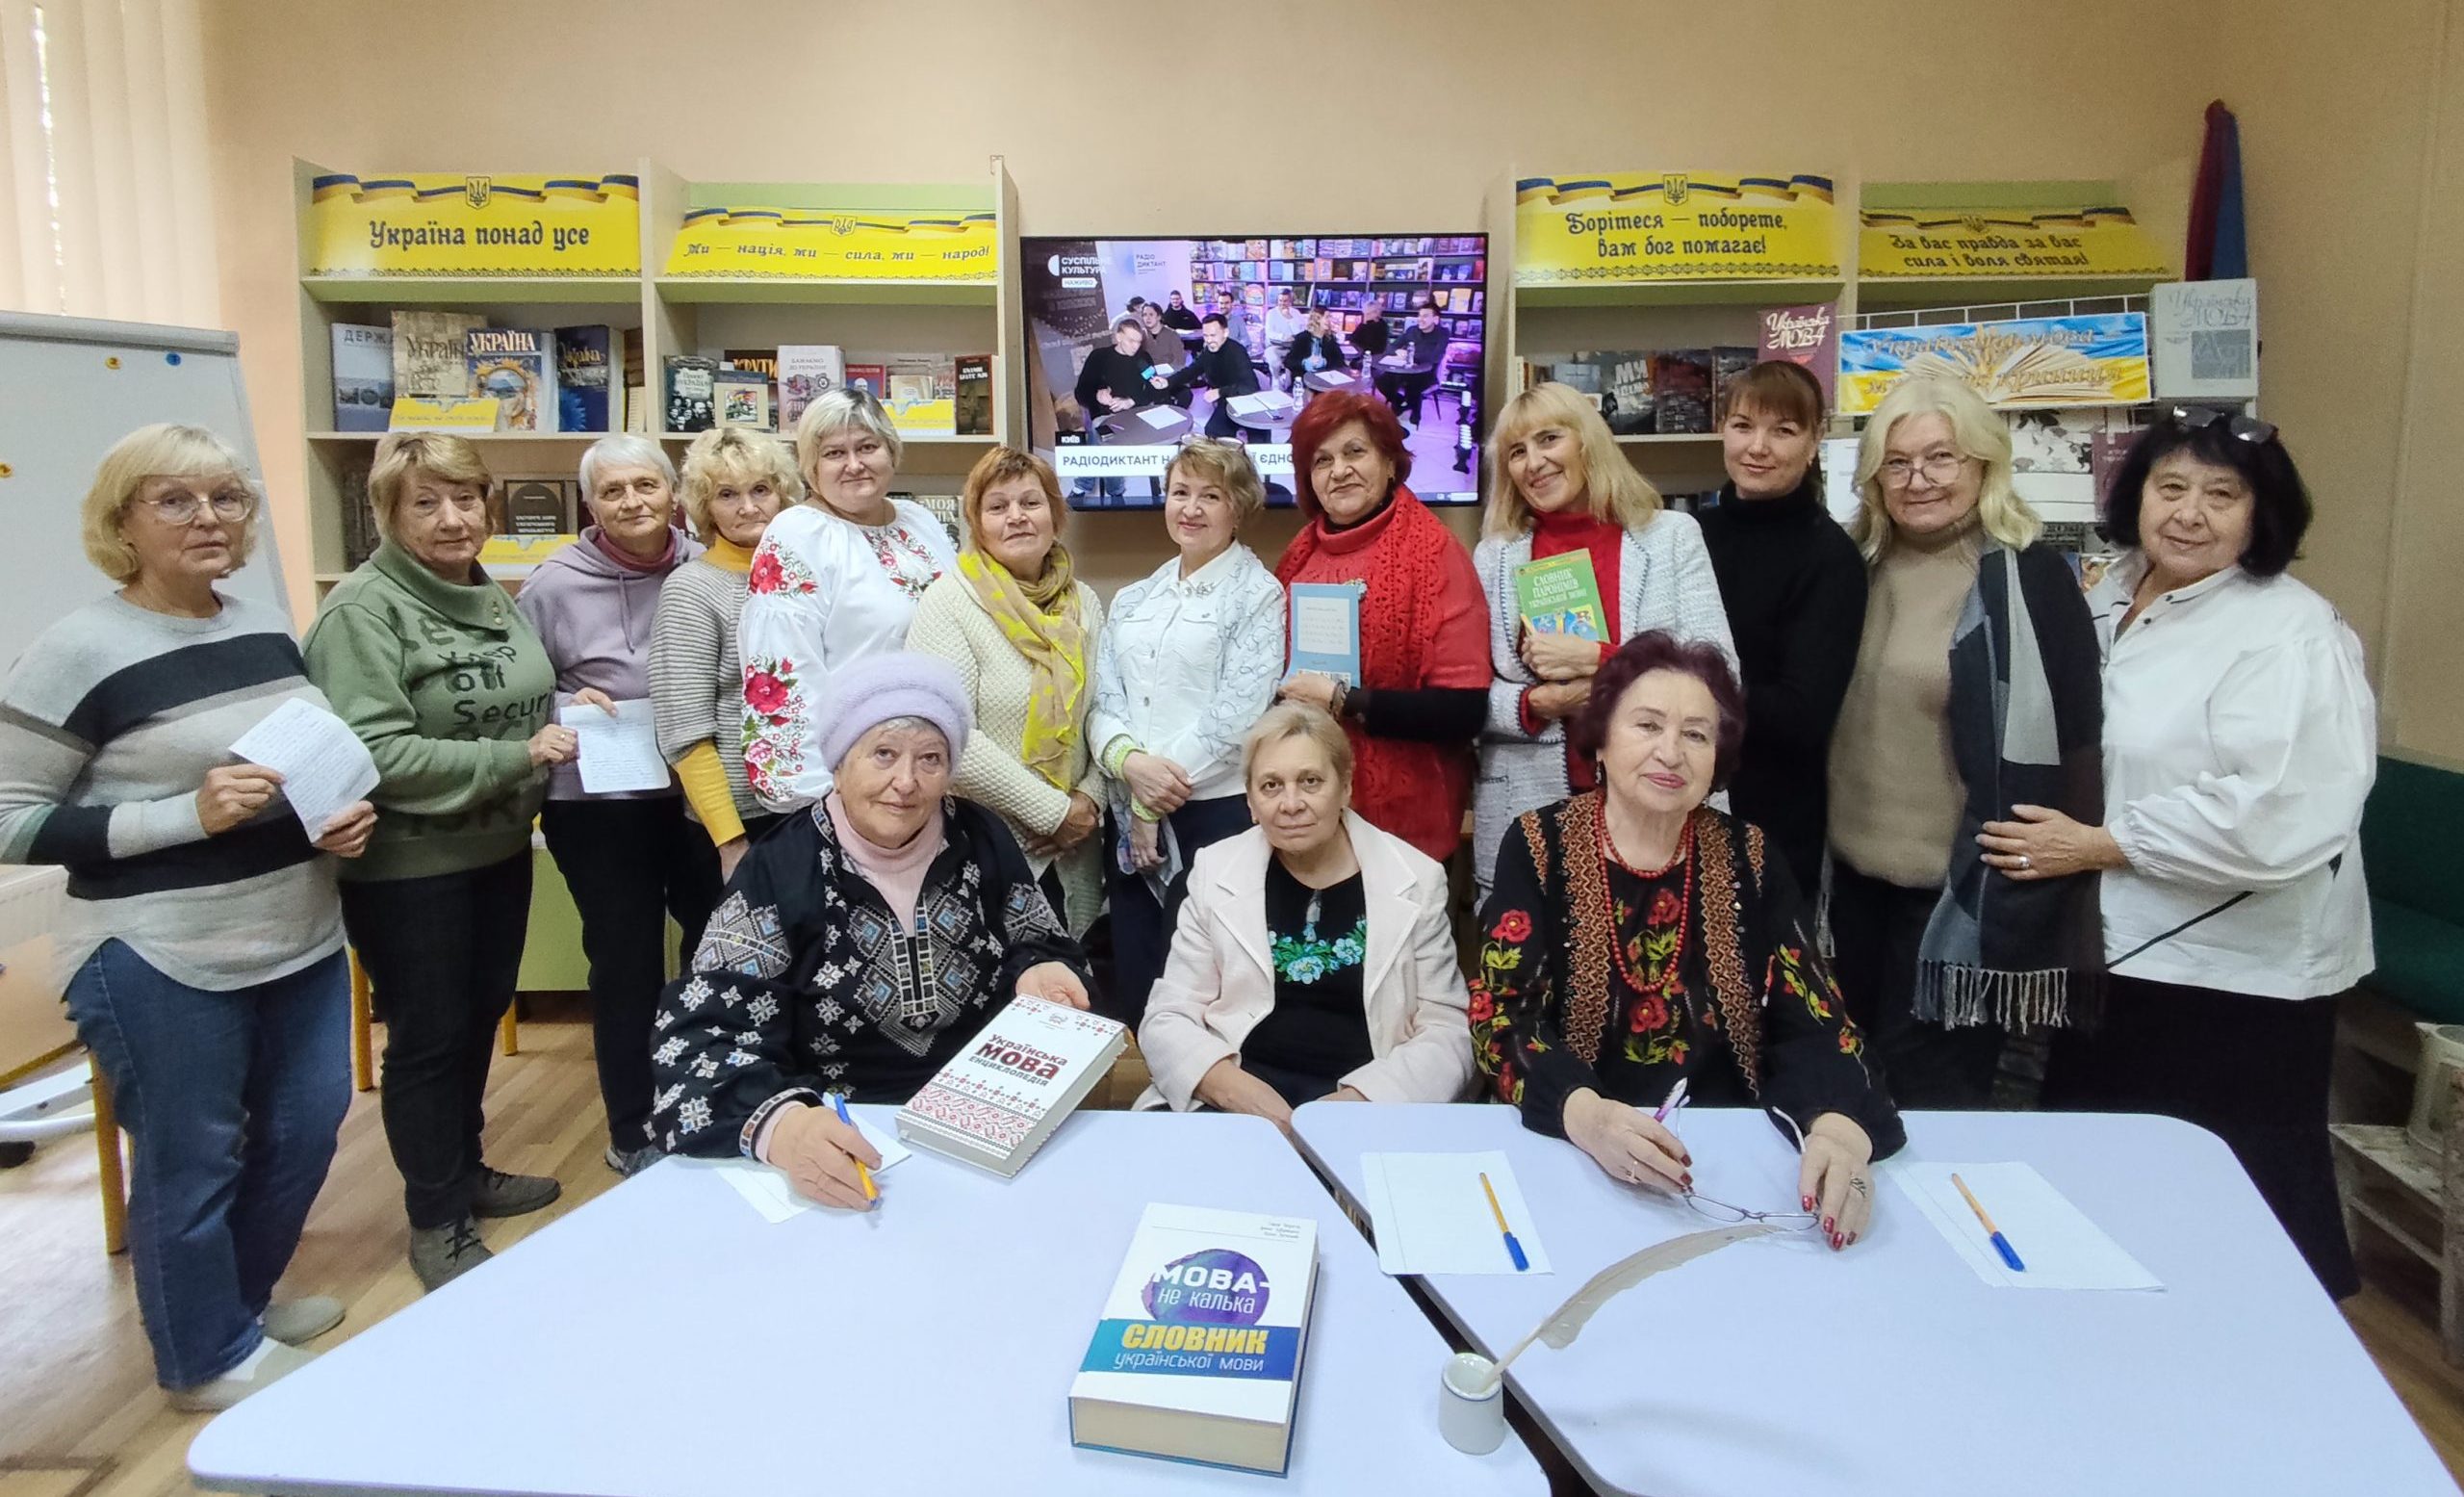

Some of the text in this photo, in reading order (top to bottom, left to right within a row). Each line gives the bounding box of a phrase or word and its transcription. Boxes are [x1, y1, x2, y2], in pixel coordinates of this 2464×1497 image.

[1565, 212, 1664, 236] Борітеся
[1699, 207, 1787, 232] поборете,
[369, 219, 590, 251] Україна понад усе
[1598, 234, 1767, 257] вам бог помагає!
[1888, 234, 2083, 251] За вас правда за вас
[683, 243, 709, 257] Ми
[792, 246, 818, 258] ми
[891, 250, 915, 261] ми
[942, 245, 990, 261] народ!
[1904, 255, 1948, 268] сила
[1950, 253, 1961, 267] і
[1963, 253, 2011, 267] воля
[1061, 266, 1108, 275] КУЛЬТУРА
[344, 329, 393, 344] ДЕРЖ
[468, 332, 536, 353] УКРАЇНА
[1766, 325, 1827, 349] МОВА
[1061, 435, 1080, 444] КИЇВ
[1062, 455, 1157, 467] РАДІОДИКТАНТ
[1260, 454, 1293, 465] ЄДНО
[988, 1033, 1068, 1067] Українська
[1188, 1291, 1256, 1314] калька
[1121, 1323, 1270, 1355] СЛОВНИК
[1113, 1351, 1265, 1372] української мови
